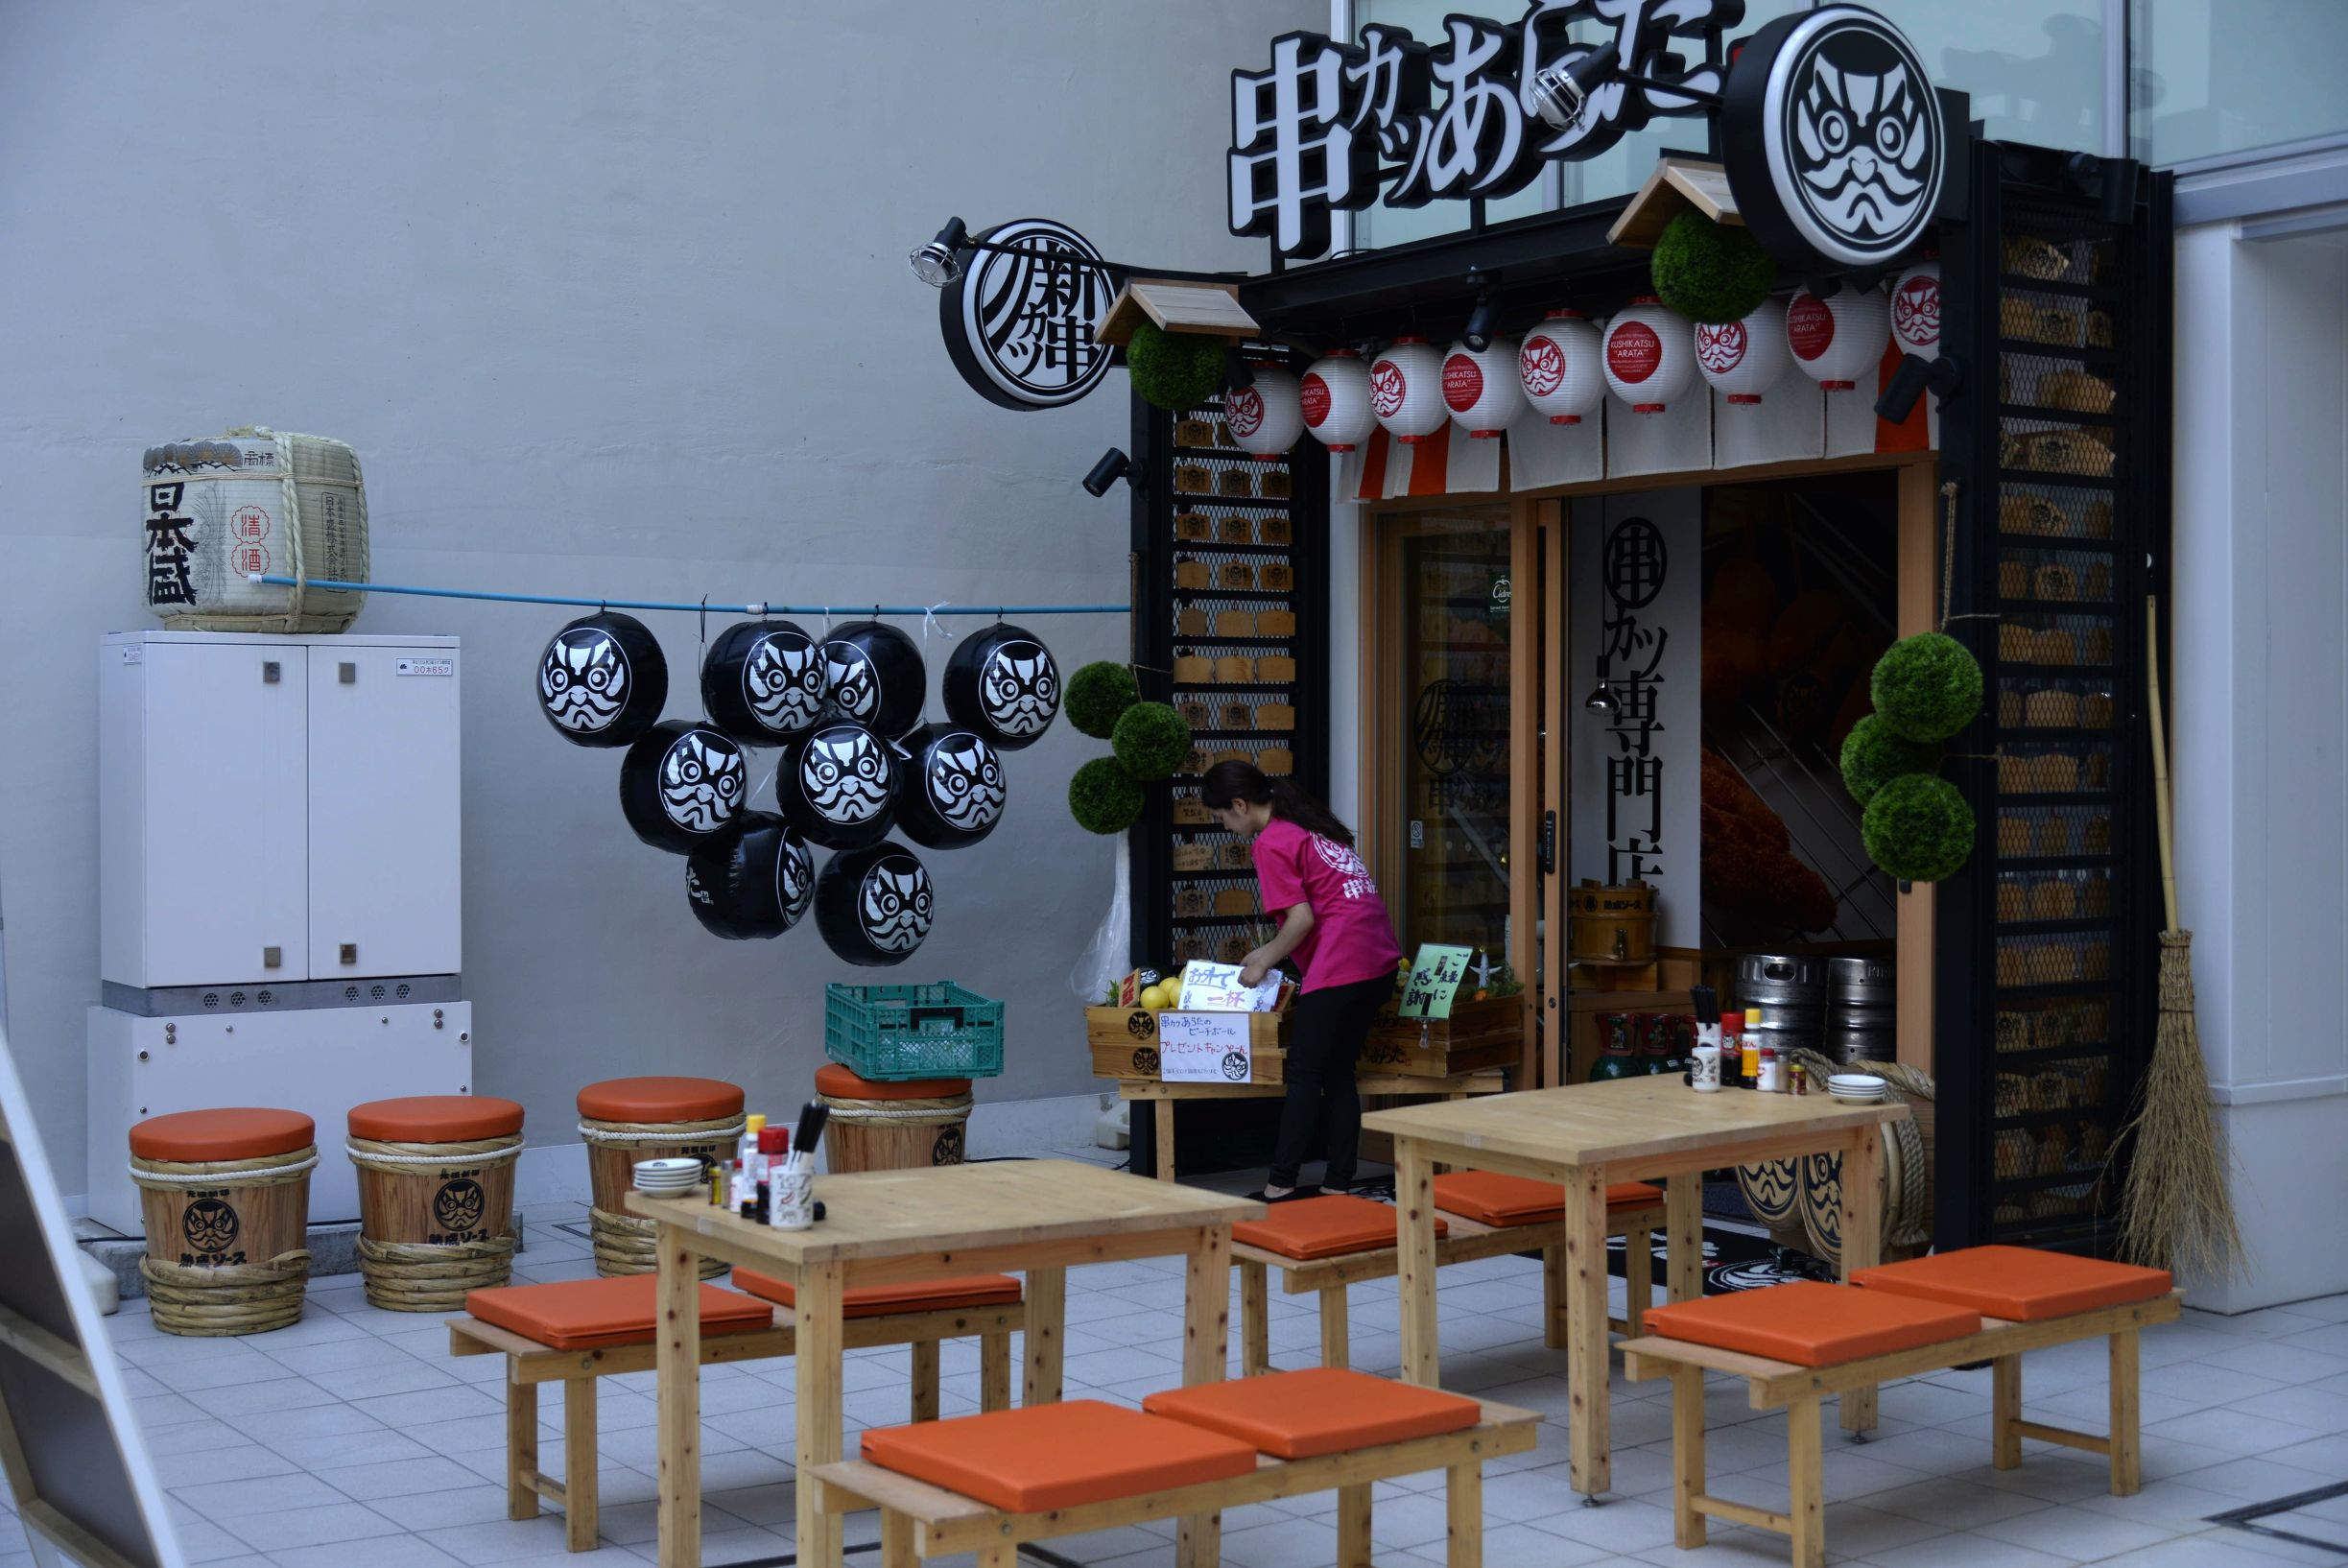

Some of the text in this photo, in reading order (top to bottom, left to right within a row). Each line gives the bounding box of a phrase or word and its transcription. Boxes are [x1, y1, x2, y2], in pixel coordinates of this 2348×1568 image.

[1611, 339, 1654, 348] KUSHIKATSU
[145, 483, 200, 606] 日本盛
[241, 514, 261, 572] 清酒
[1207, 990, 1245, 1007] 一杯
